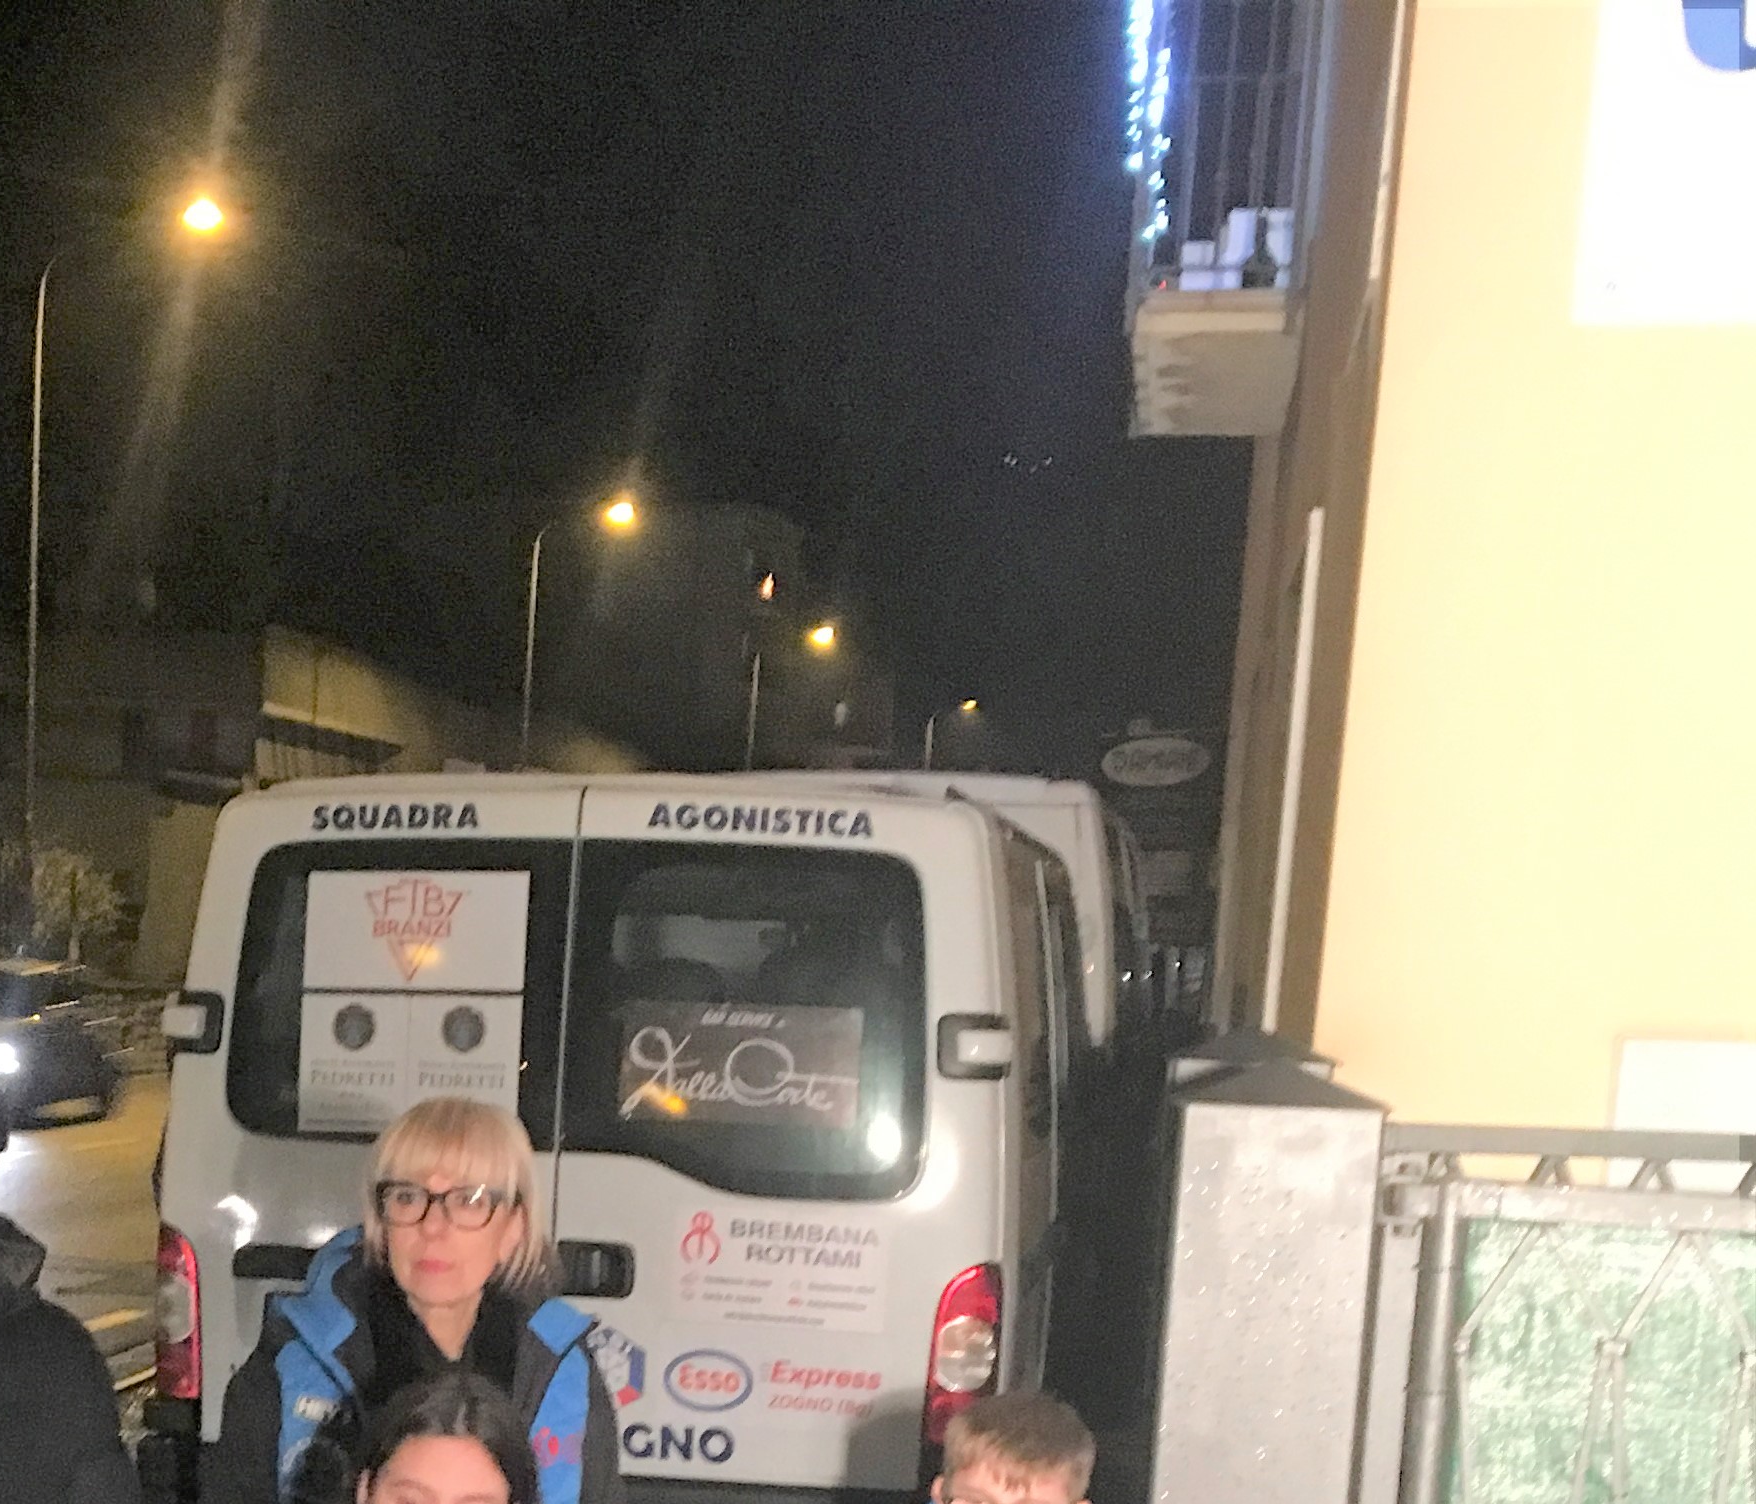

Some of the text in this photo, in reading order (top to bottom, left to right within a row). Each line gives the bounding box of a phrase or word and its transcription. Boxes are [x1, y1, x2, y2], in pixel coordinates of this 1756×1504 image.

[311, 802, 874, 838] SQUADRA AGONISTICA
[372, 919, 451, 938] BRANZI
[729, 1218, 880, 1247] BREMBANA
[745, 1243, 862, 1269] ROTTAMI
[770, 1359, 883, 1390] Express
[768, 1394, 834, 1413] ZOGNO
[621, 1423, 735, 1464] GNO
